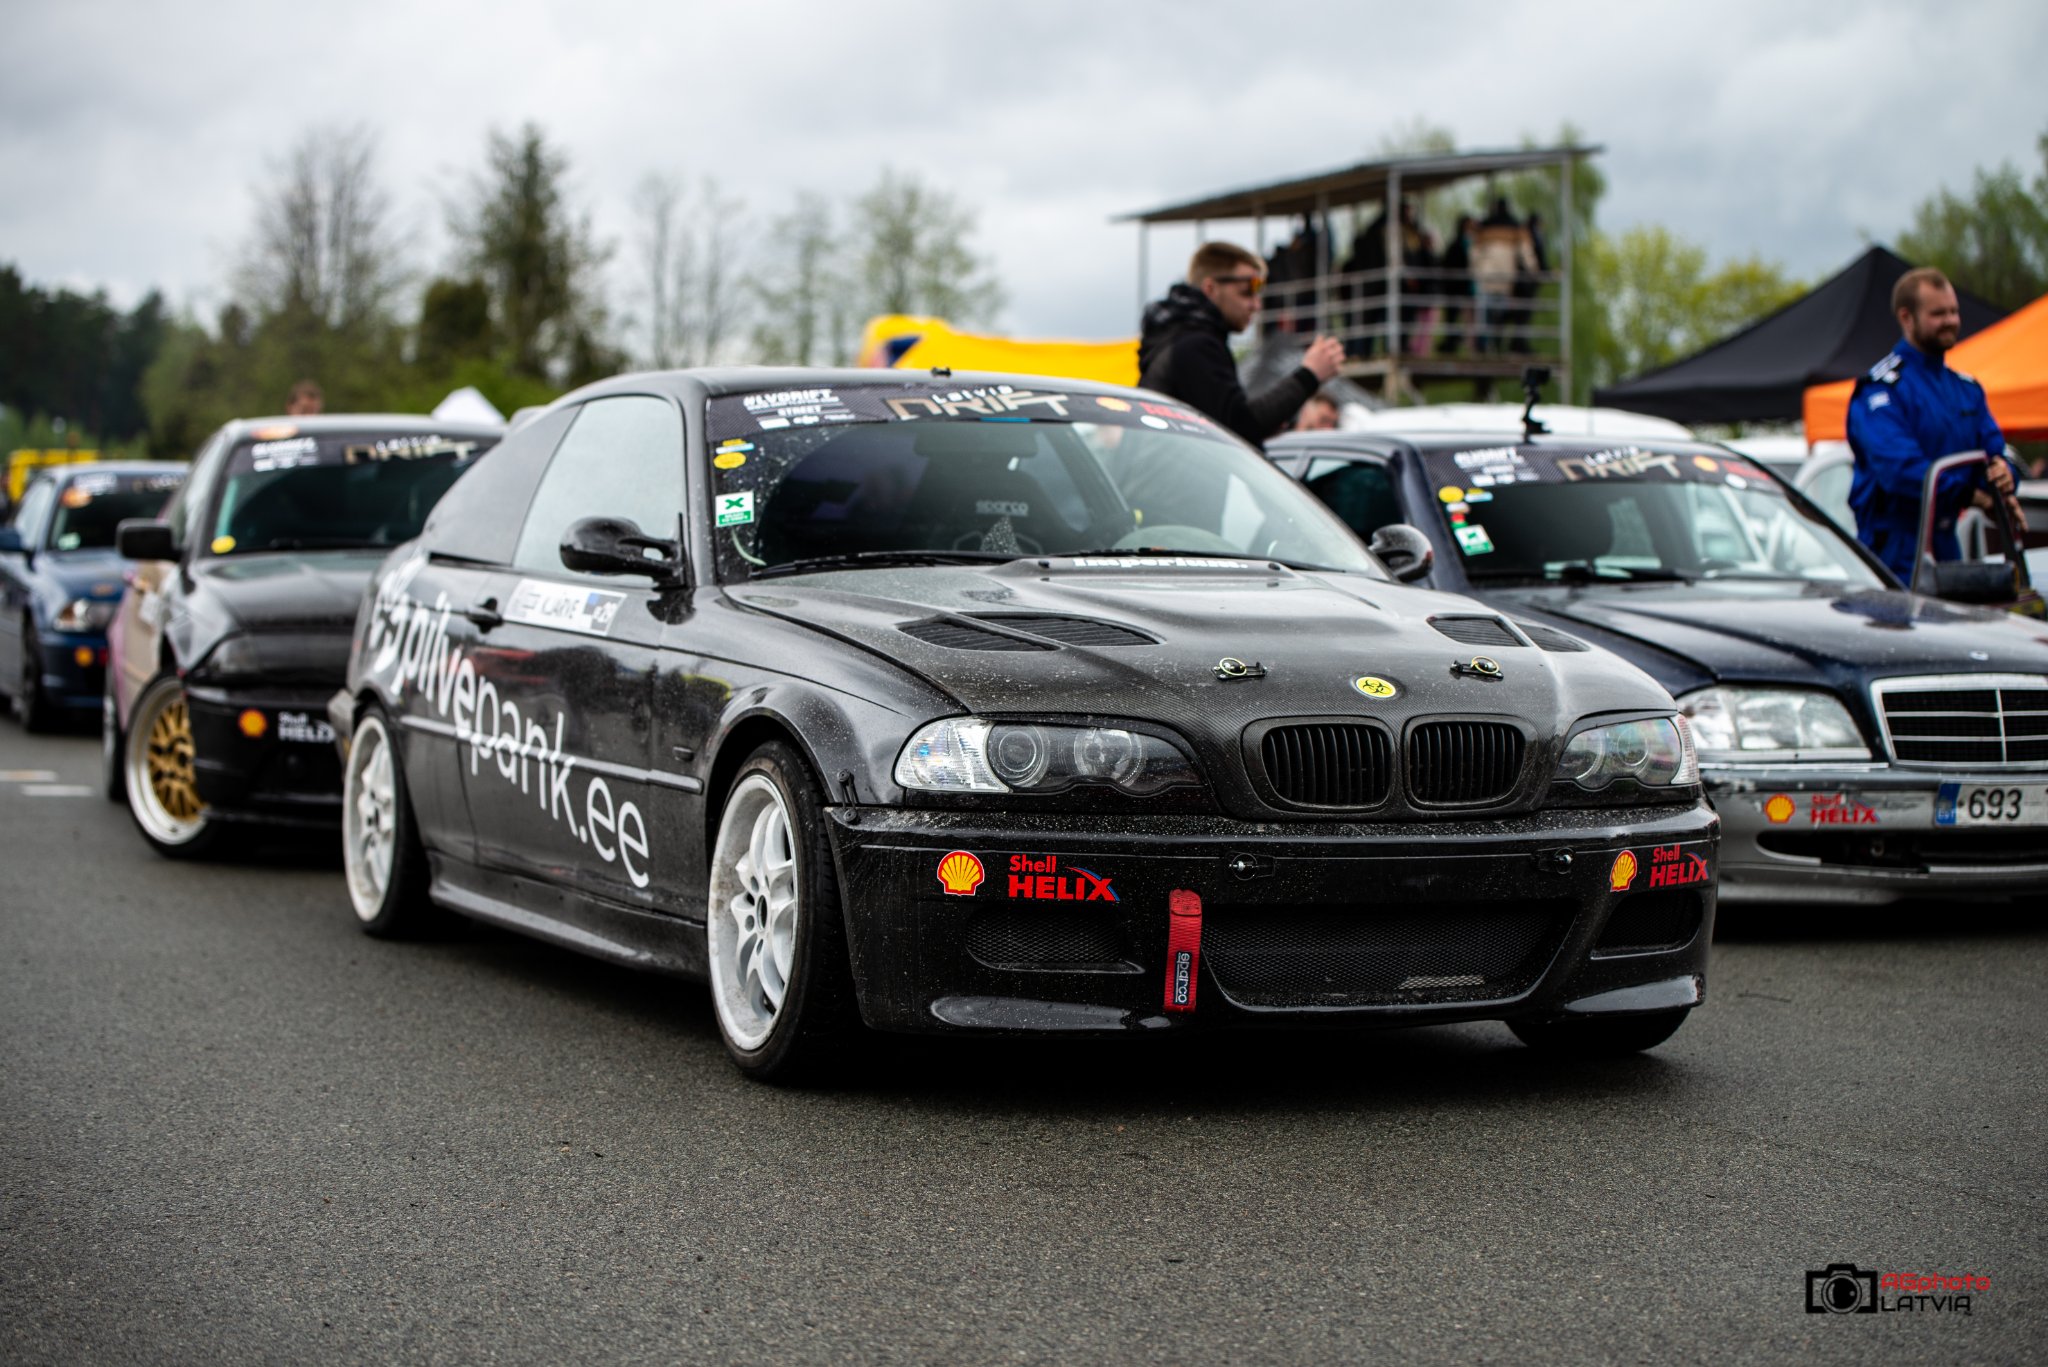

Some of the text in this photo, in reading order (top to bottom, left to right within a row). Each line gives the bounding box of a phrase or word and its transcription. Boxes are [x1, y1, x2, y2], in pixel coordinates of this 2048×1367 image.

[886, 391, 1069, 421] DRIFT
[1810, 804, 1879, 825] HELIX
[1968, 788, 2023, 822] 693
[1009, 855, 1057, 873] Shell
[1653, 844, 1681, 864] Shell
[1008, 869, 1119, 901] HELIX
[1649, 857, 1709, 888] HELIX
